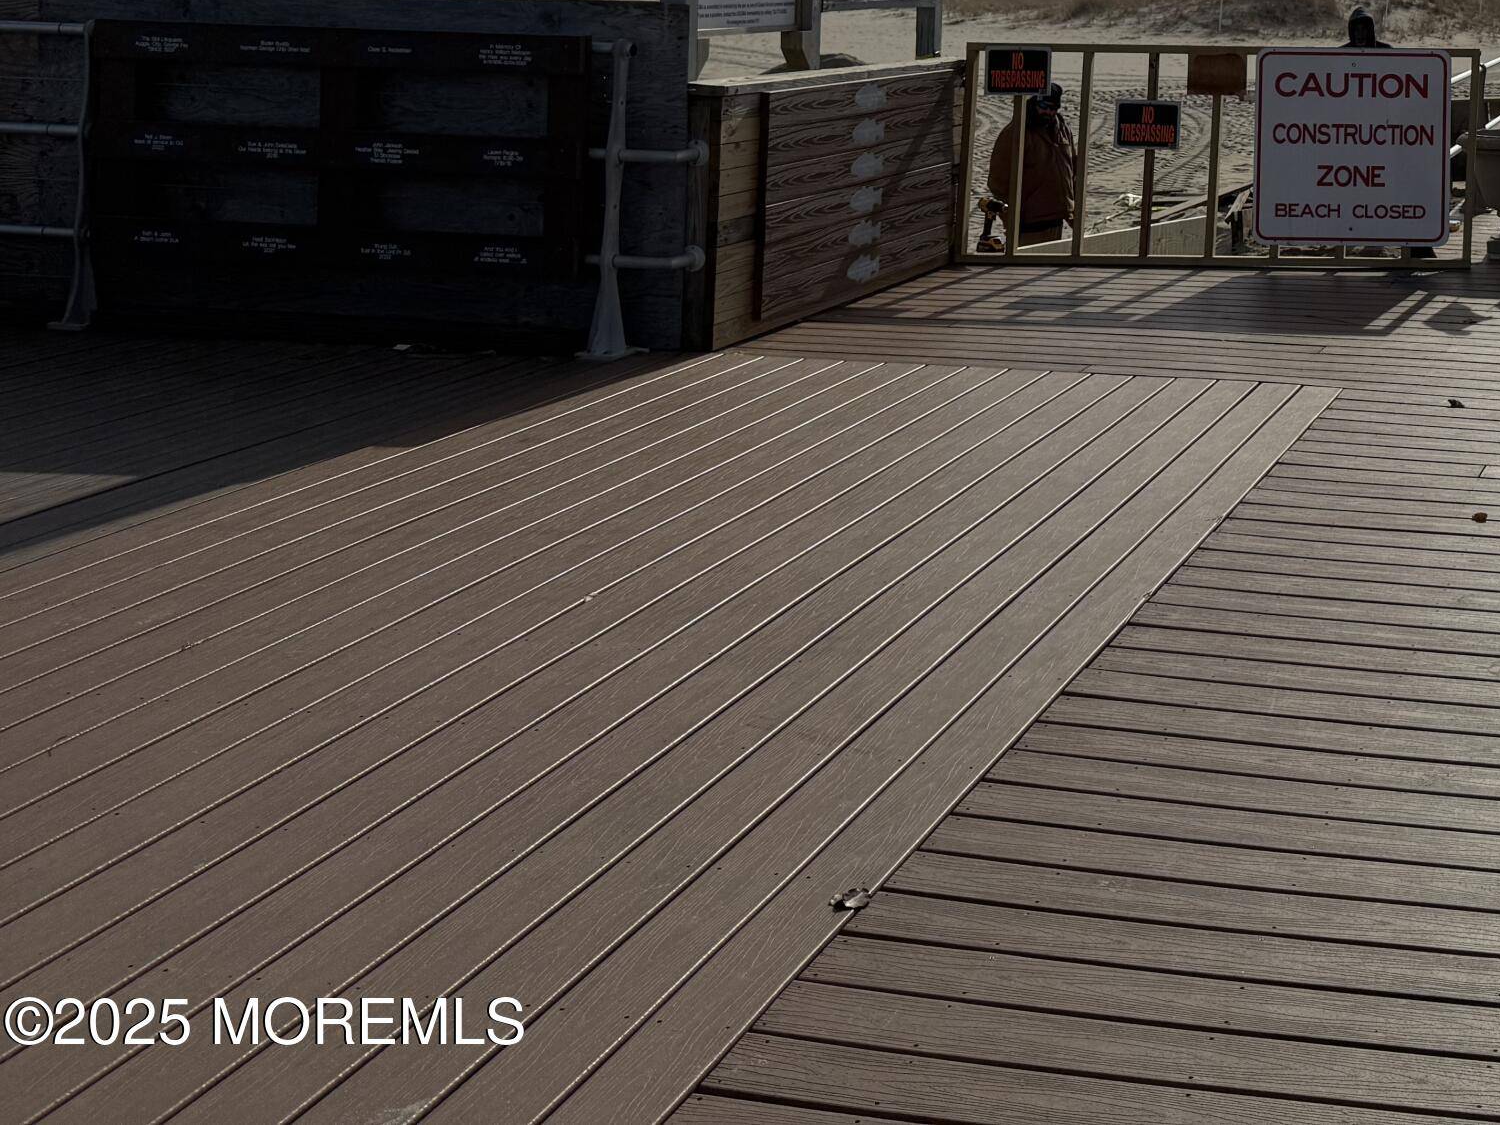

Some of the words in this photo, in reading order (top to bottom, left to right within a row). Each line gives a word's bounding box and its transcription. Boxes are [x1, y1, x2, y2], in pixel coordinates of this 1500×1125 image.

[1012, 52, 1024, 69] NO
[991, 70, 1045, 88] TRESPASSING
[1275, 72, 1429, 98] CAUTION
[1142, 106, 1155, 123] NO
[1120, 124, 1175, 143] TRESPASSING
[1272, 123, 1434, 146] CONSTRUCTION
[1317, 165, 1386, 187] ZONE
[1275, 203, 1341, 218] BEACH
[1352, 204, 1426, 219] CLOSED
